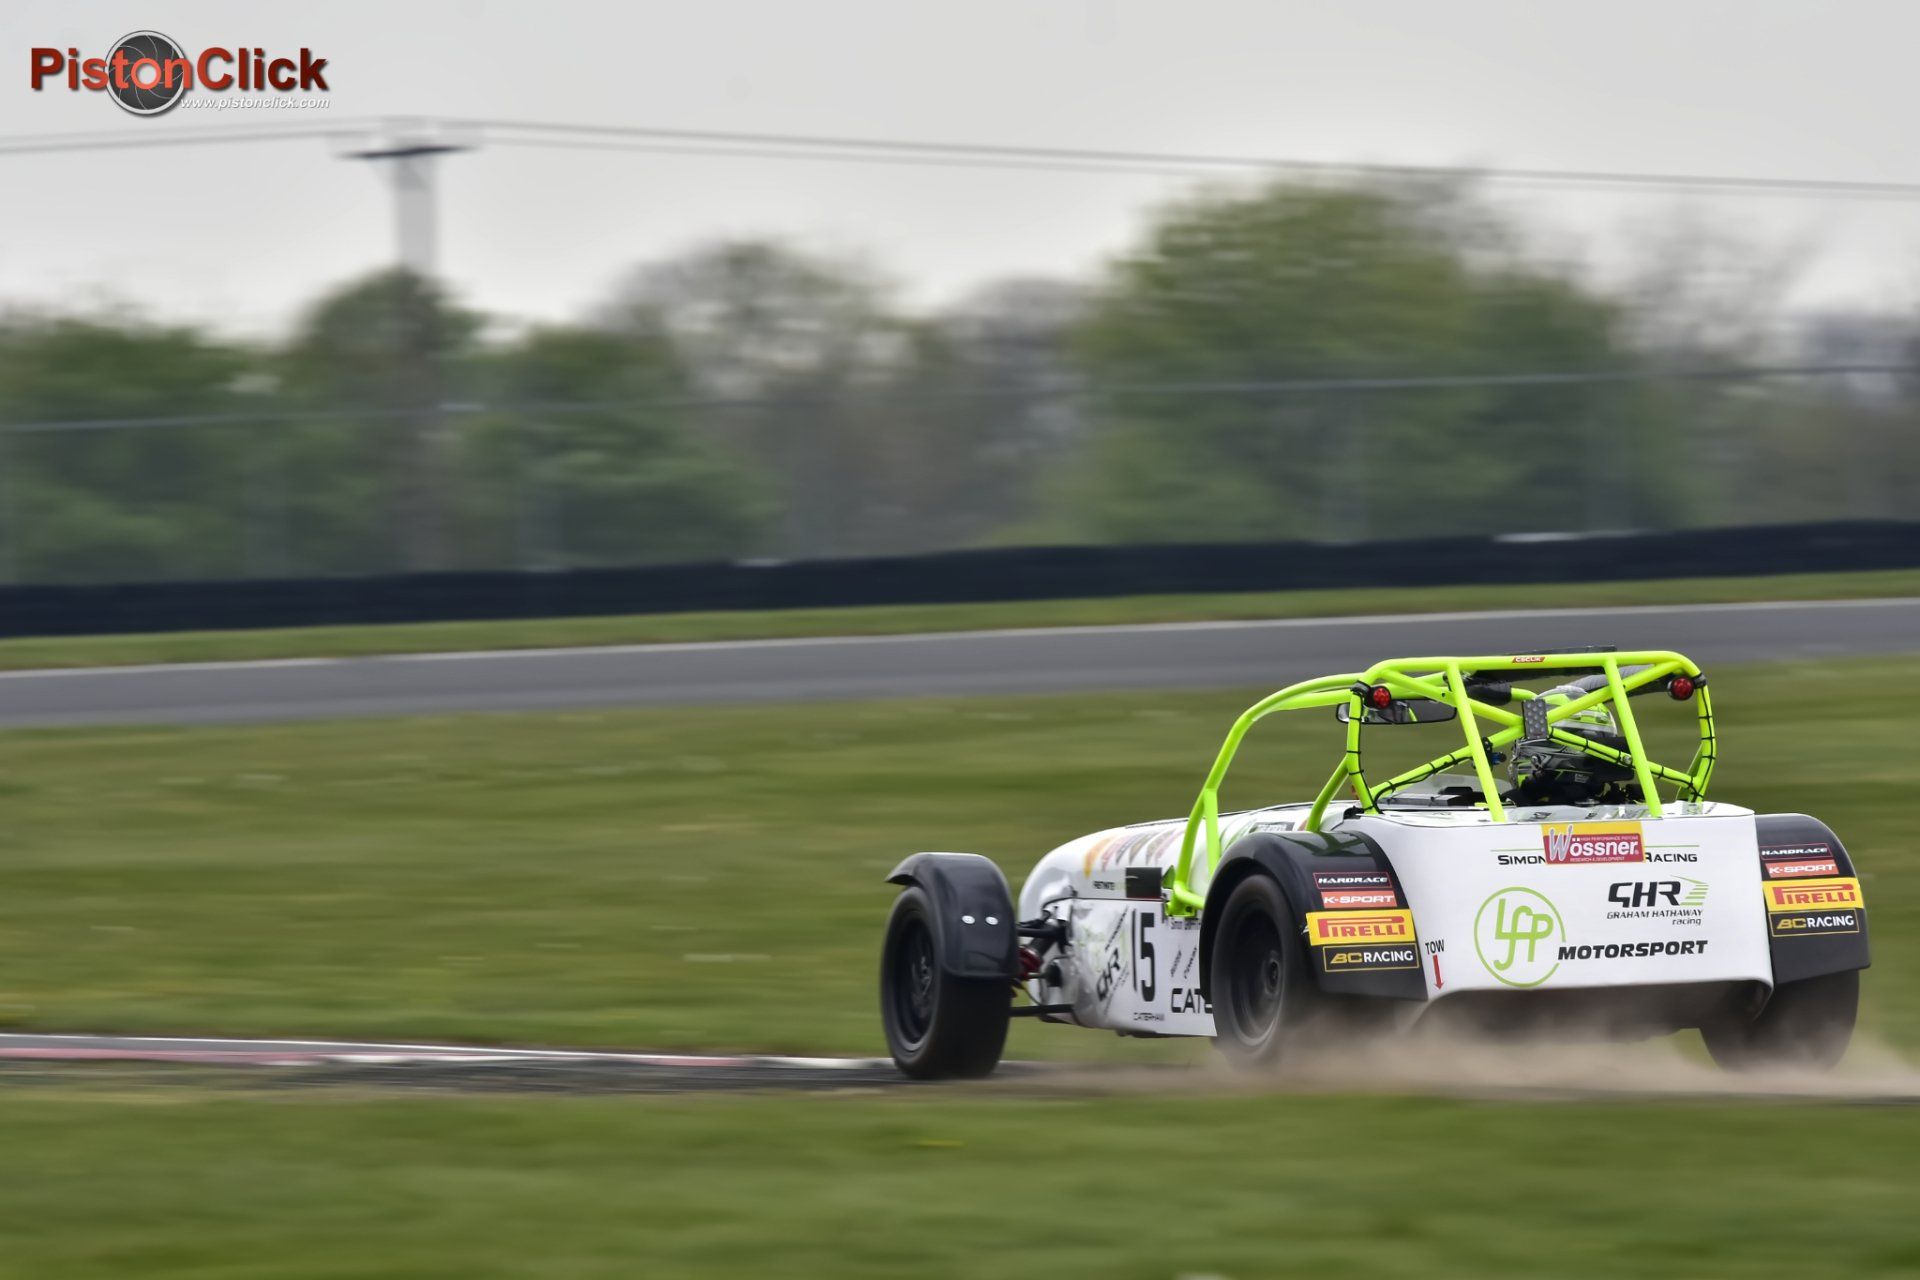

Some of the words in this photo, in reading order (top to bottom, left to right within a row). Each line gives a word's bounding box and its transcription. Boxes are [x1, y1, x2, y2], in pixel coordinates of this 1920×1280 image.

[1761, 848, 1828, 856] HARDRACE
[1769, 863, 1836, 874] K-SPORT
[1318, 876, 1388, 884] HARDRACE
[1323, 895, 1395, 904] K-SPORT
[1772, 883, 1856, 905] PIRELLI
[1606, 910, 1650, 920] GRAHAM
[1651, 909, 1703, 918] HATHAWAY
[1317, 916, 1405, 938] PIRELLI
[1672, 918, 1702, 926] racing
[1425, 939, 1445, 955] TOW
[1557, 939, 1709, 961] MOTORSPORT
[1132, 907, 1155, 1002] 15
